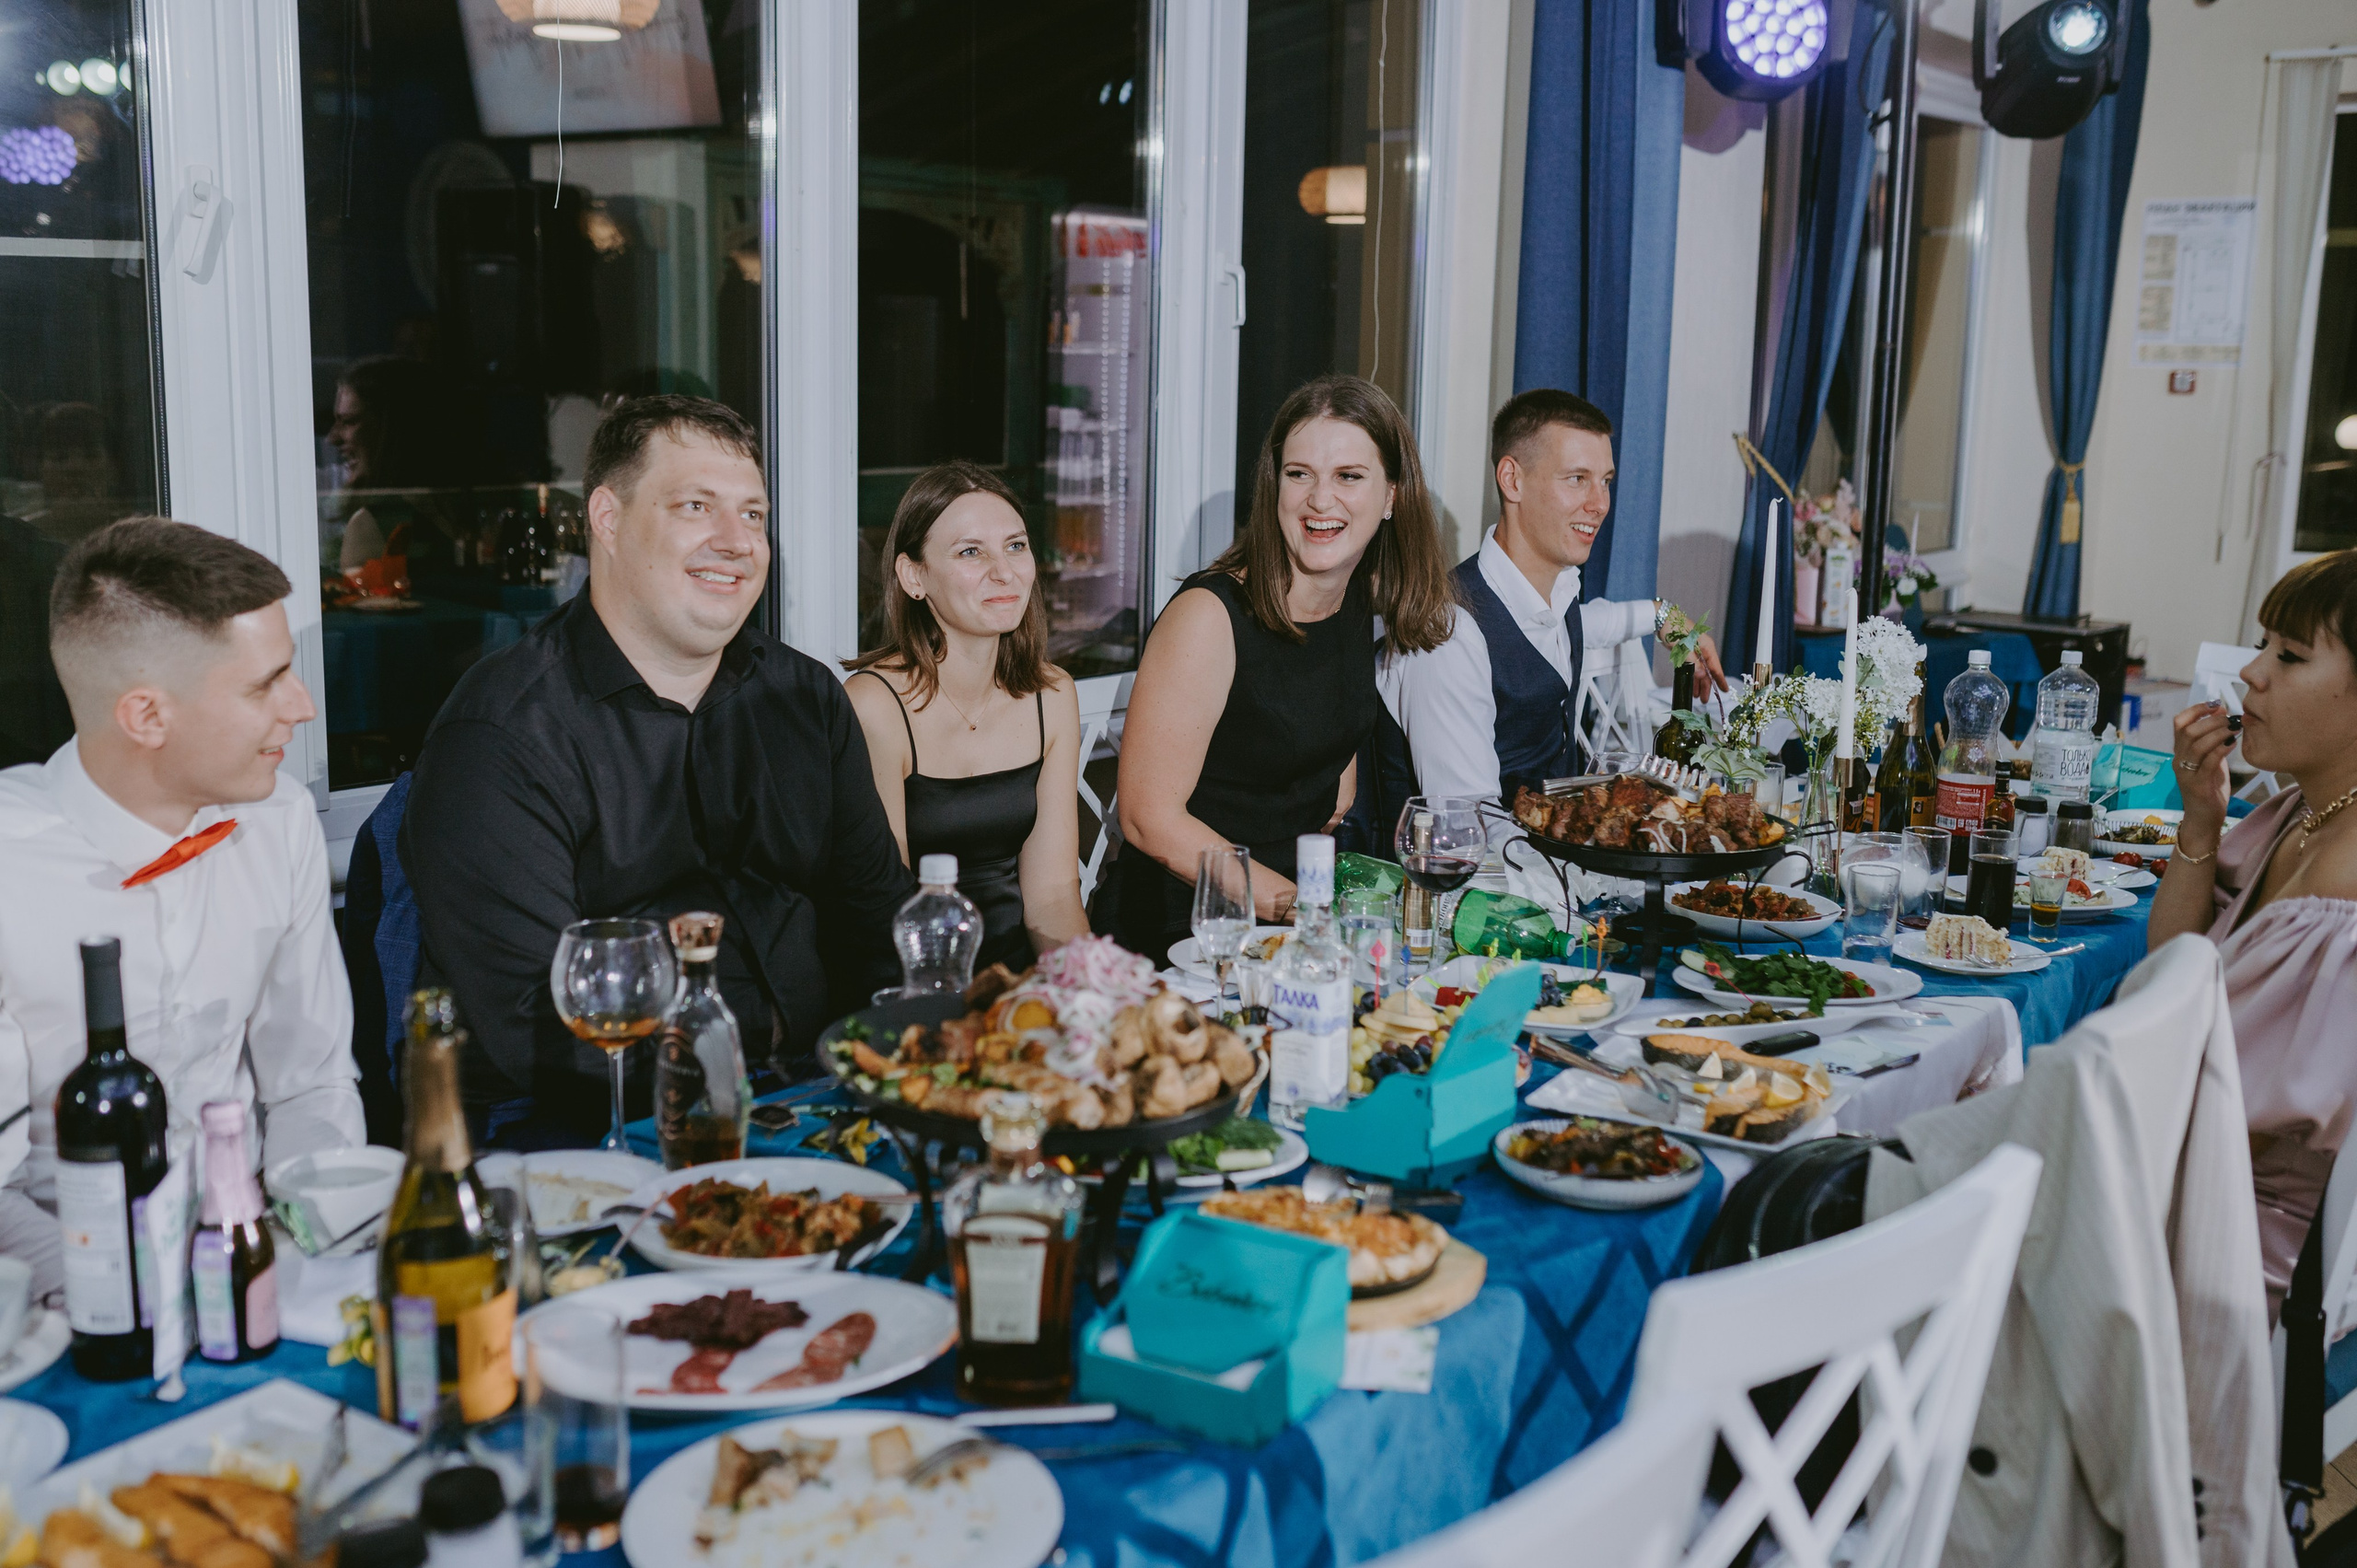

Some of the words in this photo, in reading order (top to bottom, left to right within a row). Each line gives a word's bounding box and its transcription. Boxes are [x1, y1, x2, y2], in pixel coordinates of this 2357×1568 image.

[2061, 749, 2092, 762] ТОЛЬКО
[2060, 761, 2087, 776] ВОДА
[1273, 983, 1319, 1011] ТАЛКА
